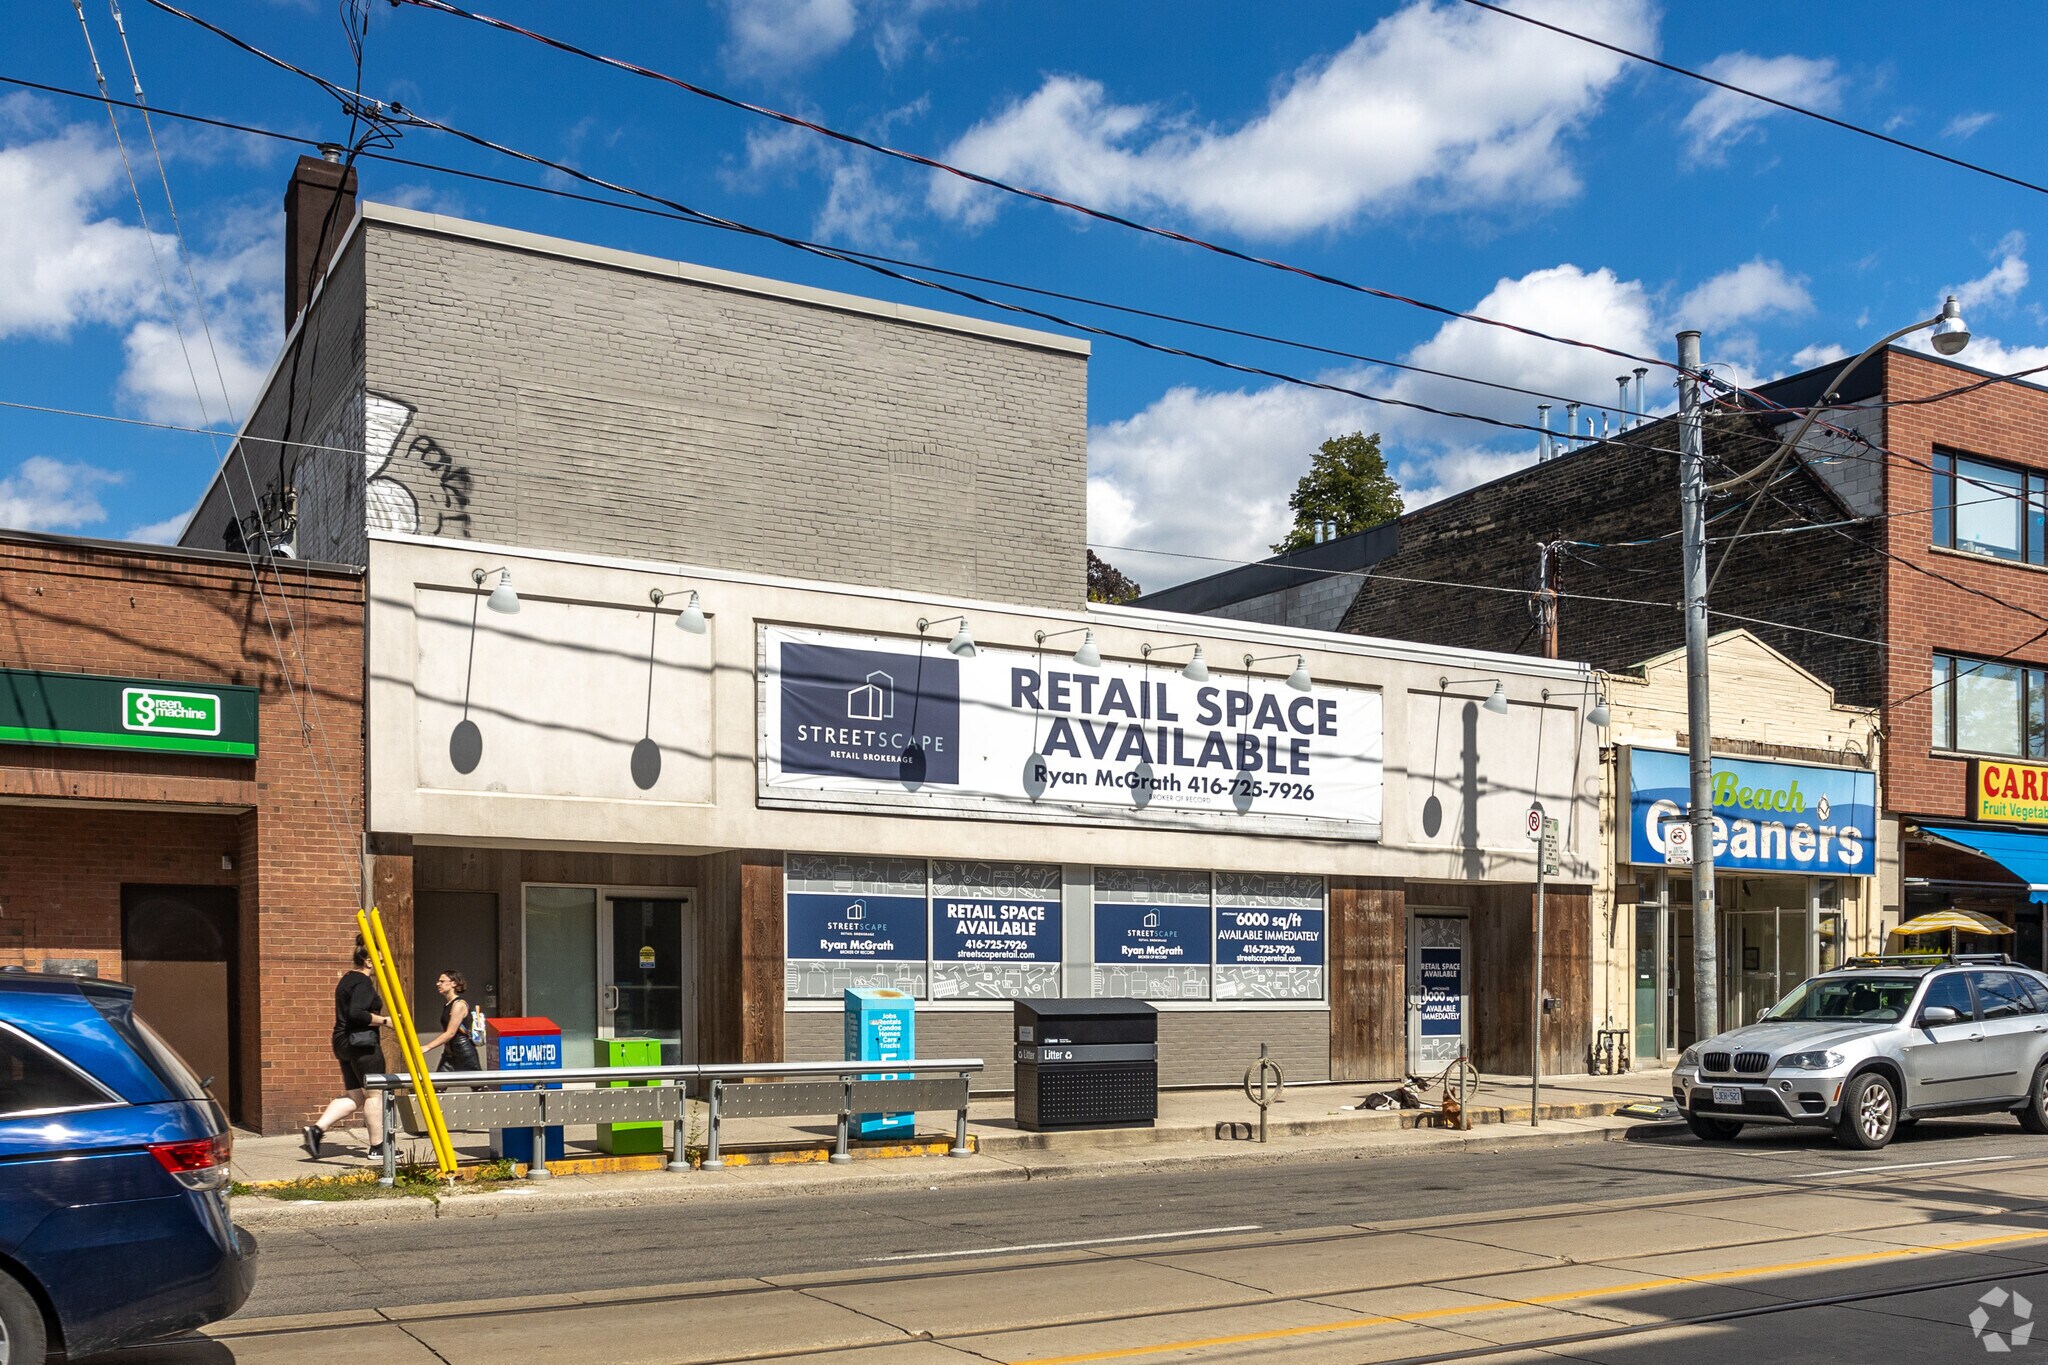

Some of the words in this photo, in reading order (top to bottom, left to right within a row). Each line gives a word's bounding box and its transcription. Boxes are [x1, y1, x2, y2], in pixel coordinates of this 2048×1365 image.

[1011, 667, 1178, 722] RETAIL
[1196, 686, 1337, 736] SPACE
[136, 694, 182, 727] green
[155, 707, 206, 719] machine
[798, 725, 943, 752] STREETSCAPE
[1041, 717, 1310, 775] AVAILABLE
[830, 751, 860, 759] RETAIL
[863, 753, 913, 764] BROKERAGE
[1034, 765, 1087, 788] Ryan
[1095, 769, 1181, 792] McGrath
[1187, 777, 1315, 801] 416-725-7926
[1149, 793, 1173, 801] BROKER
[1712, 771, 1806, 813] Beach
[1983, 800, 2006, 816] Fruit
[1646, 799, 1863, 865] Ceaners
[947, 904, 996, 919] RETAIL
[1000, 905, 1045, 920] SPACE
[827, 922, 887, 931] STREETSCAPE
[1236, 912, 1269, 926] 6000
[1272, 913, 1302, 930] sq/ft
[956, 920, 1036, 936] AVAILABLE
[1127, 929, 1178, 937] STREETSCAPE
[1218, 930, 1263, 940] AVAILABLE
[1264, 931, 1319, 941] IMMEDIATELY
[820, 939, 847, 952] Ryan
[850, 939, 894, 951] McGrath
[965, 940, 1027, 950] 416-725-7926
[1121, 945, 1144, 957] Ryan
[1146, 945, 1183, 955] McGrath
[1243, 945, 1295, 954] 416-725-7926
[957, 950, 1035, 960] streetscaperetail.com
[1236, 954, 1301, 964] streetscaperetail.com
[1422, 1012, 1460, 1020] IMMEDIATELY
[505, 1045, 525, 1062] HELP
[525, 1044, 556, 1061] WANTED
[1024, 1049, 1035, 1059] Litter
[1044, 1050, 1062, 1060] Litter
